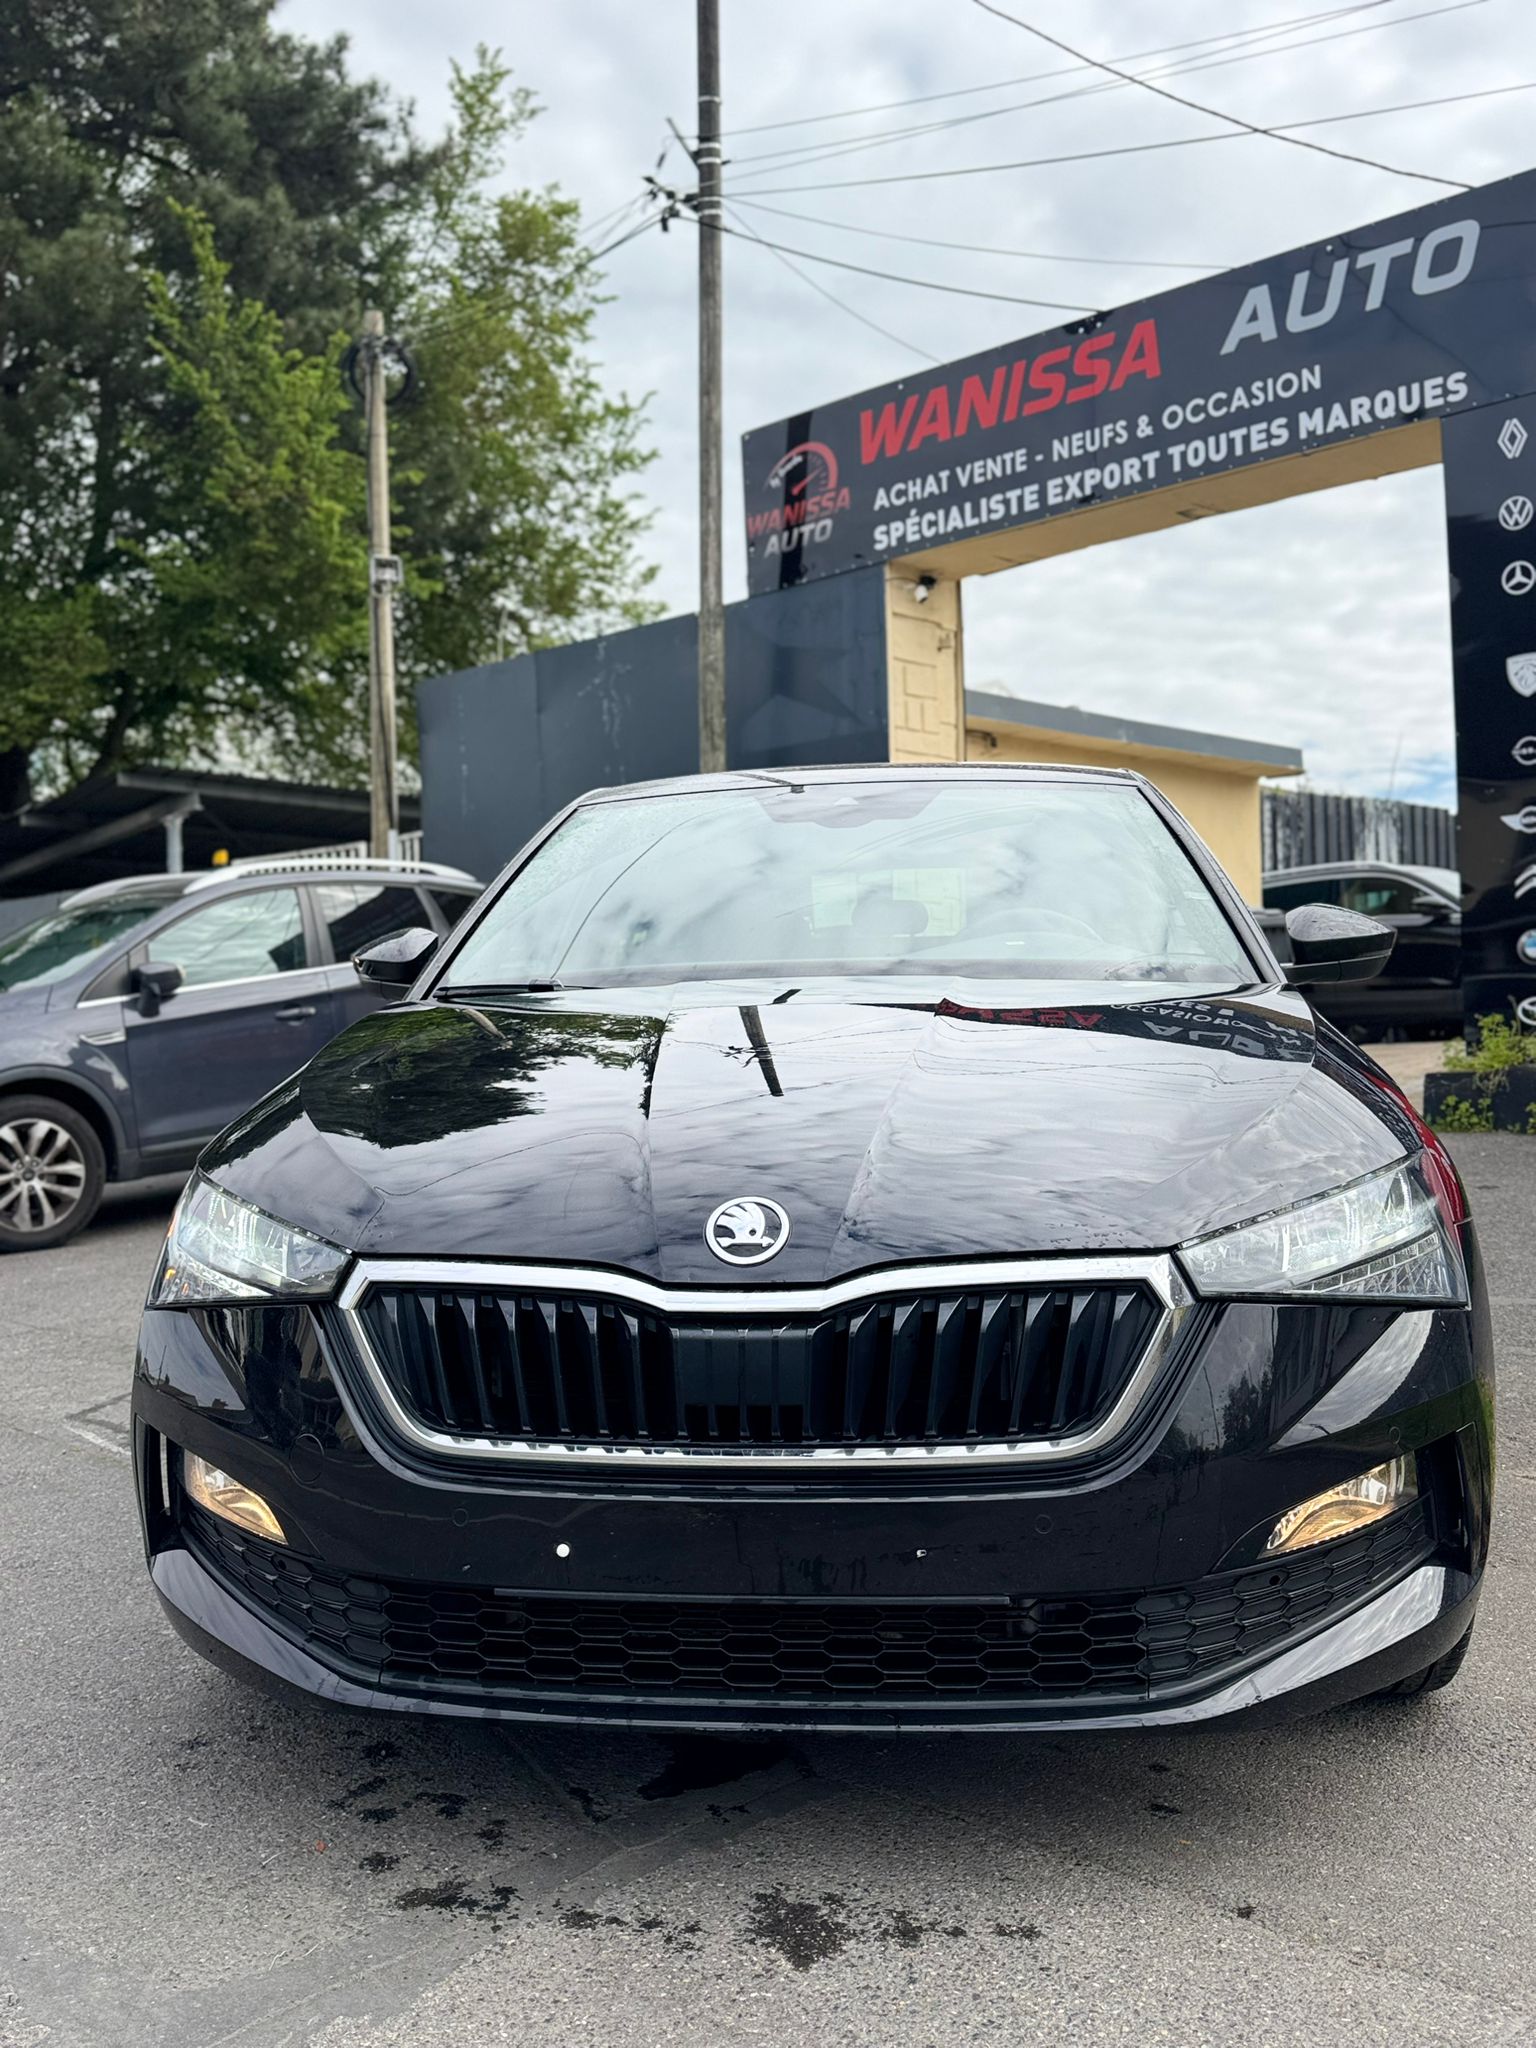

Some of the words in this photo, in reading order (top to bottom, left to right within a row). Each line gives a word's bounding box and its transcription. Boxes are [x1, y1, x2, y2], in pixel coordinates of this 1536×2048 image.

[859, 319, 1162, 465] WANISSA
[1219, 219, 1481, 356] AUTO
[873, 469, 950, 511] ACHAT
[956, 448, 1027, 488] VENTE
[1052, 419, 1128, 462] NEUFS
[1136, 414, 1154, 438] &
[1161, 364, 1321, 430] OCCASION
[873, 484, 1040, 550] SPÉCIALISTE
[1047, 450, 1160, 506] EXPORT
[1167, 416, 1290, 472] TOUTES
[1298, 371, 1468, 440] MARQUES
[747, 486, 850, 539] WANISSA
[763, 518, 833, 558] AUTO
